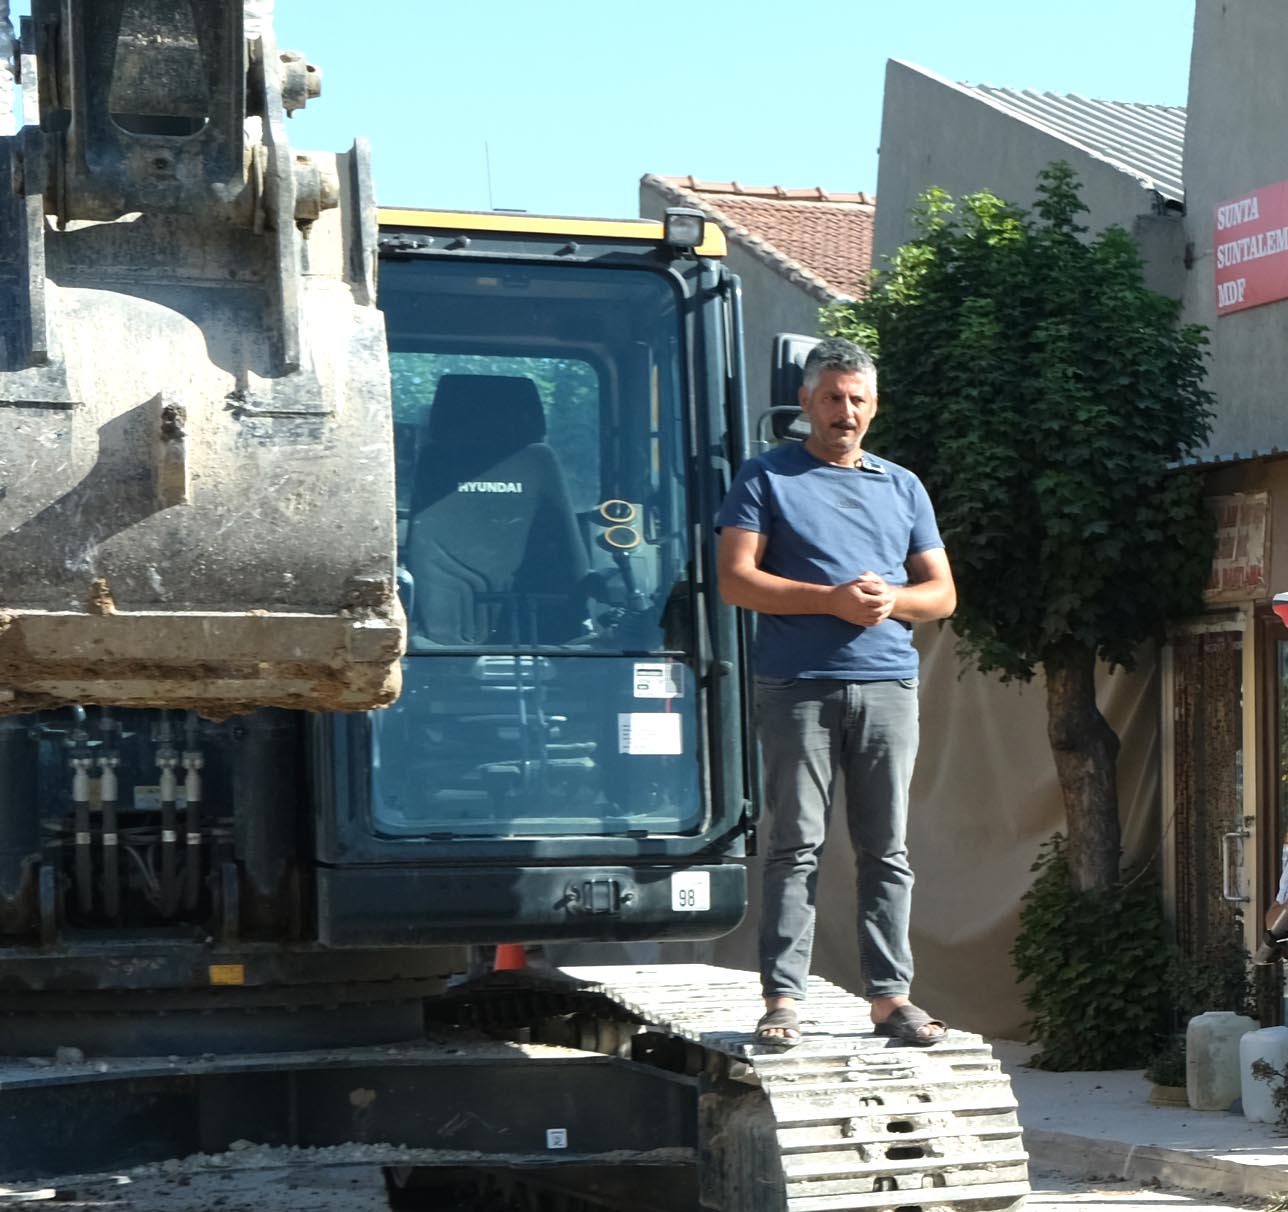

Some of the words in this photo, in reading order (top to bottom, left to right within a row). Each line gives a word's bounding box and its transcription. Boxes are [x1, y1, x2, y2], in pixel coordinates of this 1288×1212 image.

[1217, 196, 1260, 231] SUNTA
[1217, 278, 1246, 308] MDF
[458, 481, 522, 493] HYUNDAI
[679, 889, 695, 906] 98
